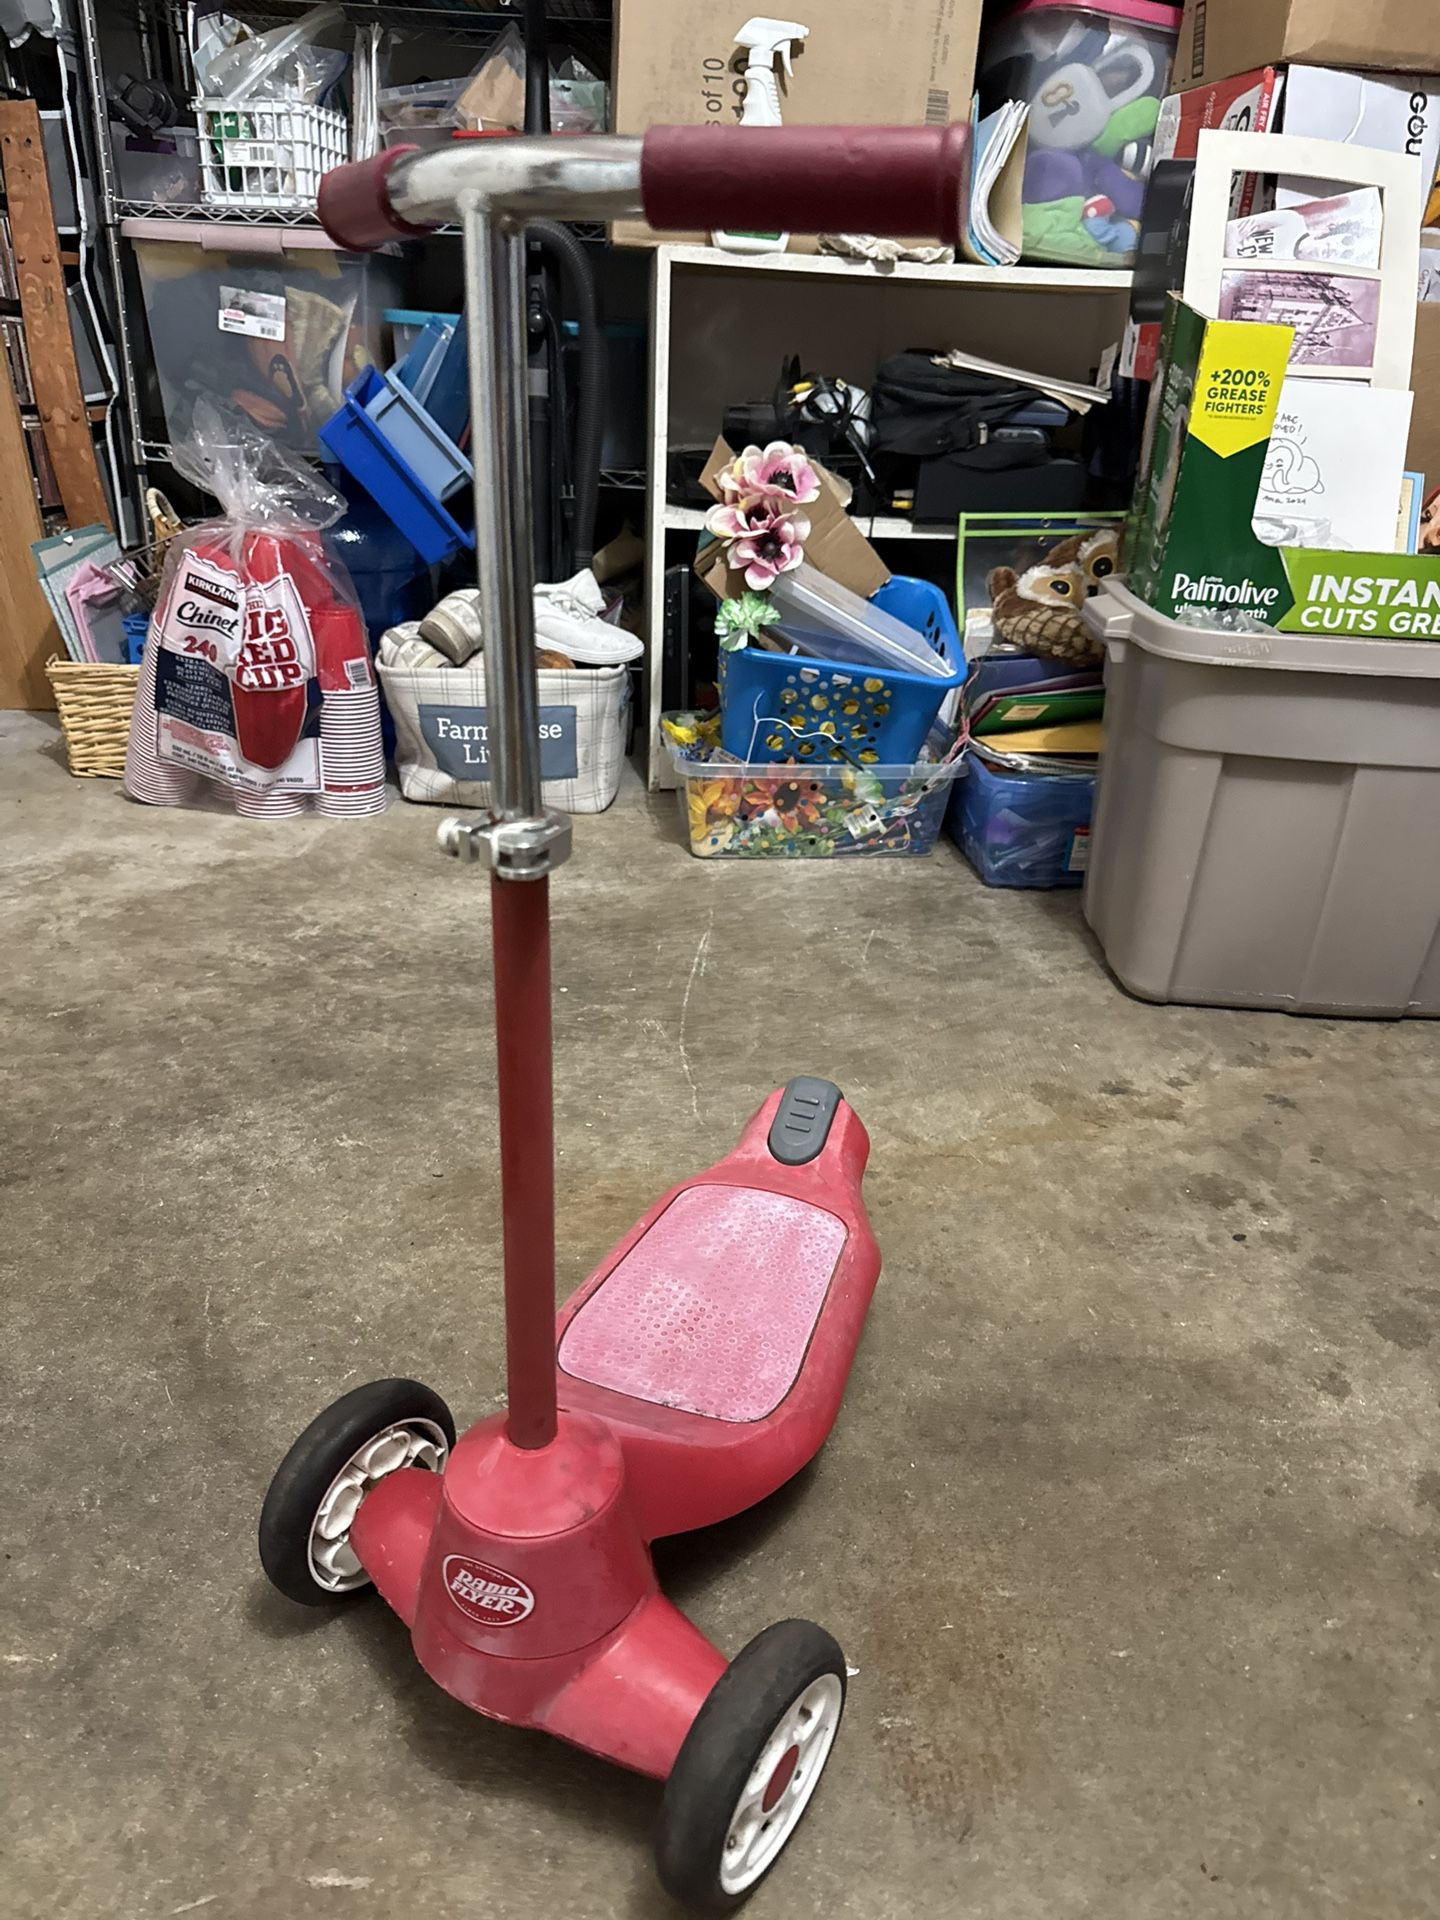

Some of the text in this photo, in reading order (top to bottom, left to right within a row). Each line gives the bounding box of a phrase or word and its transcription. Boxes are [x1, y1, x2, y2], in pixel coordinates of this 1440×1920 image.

[702, 57, 725, 84] 10
[702, 89, 724, 113] of
[1258, 92, 1271, 127] AIR FRY
[1210, 368, 1271, 388] +200%
[1207, 386, 1268, 402] GREASE
[1171, 573, 1279, 606] Palmolive
[176, 601, 239, 635] Chinet
[242, 608, 289, 641] IG
[1300, 606, 1379, 631] CUTS
[183, 635, 218, 663] 240
[236, 663, 301, 689] CUP
[436, 717, 563, 741] Farmse
[454, 1568, 520, 1597] RADIO
